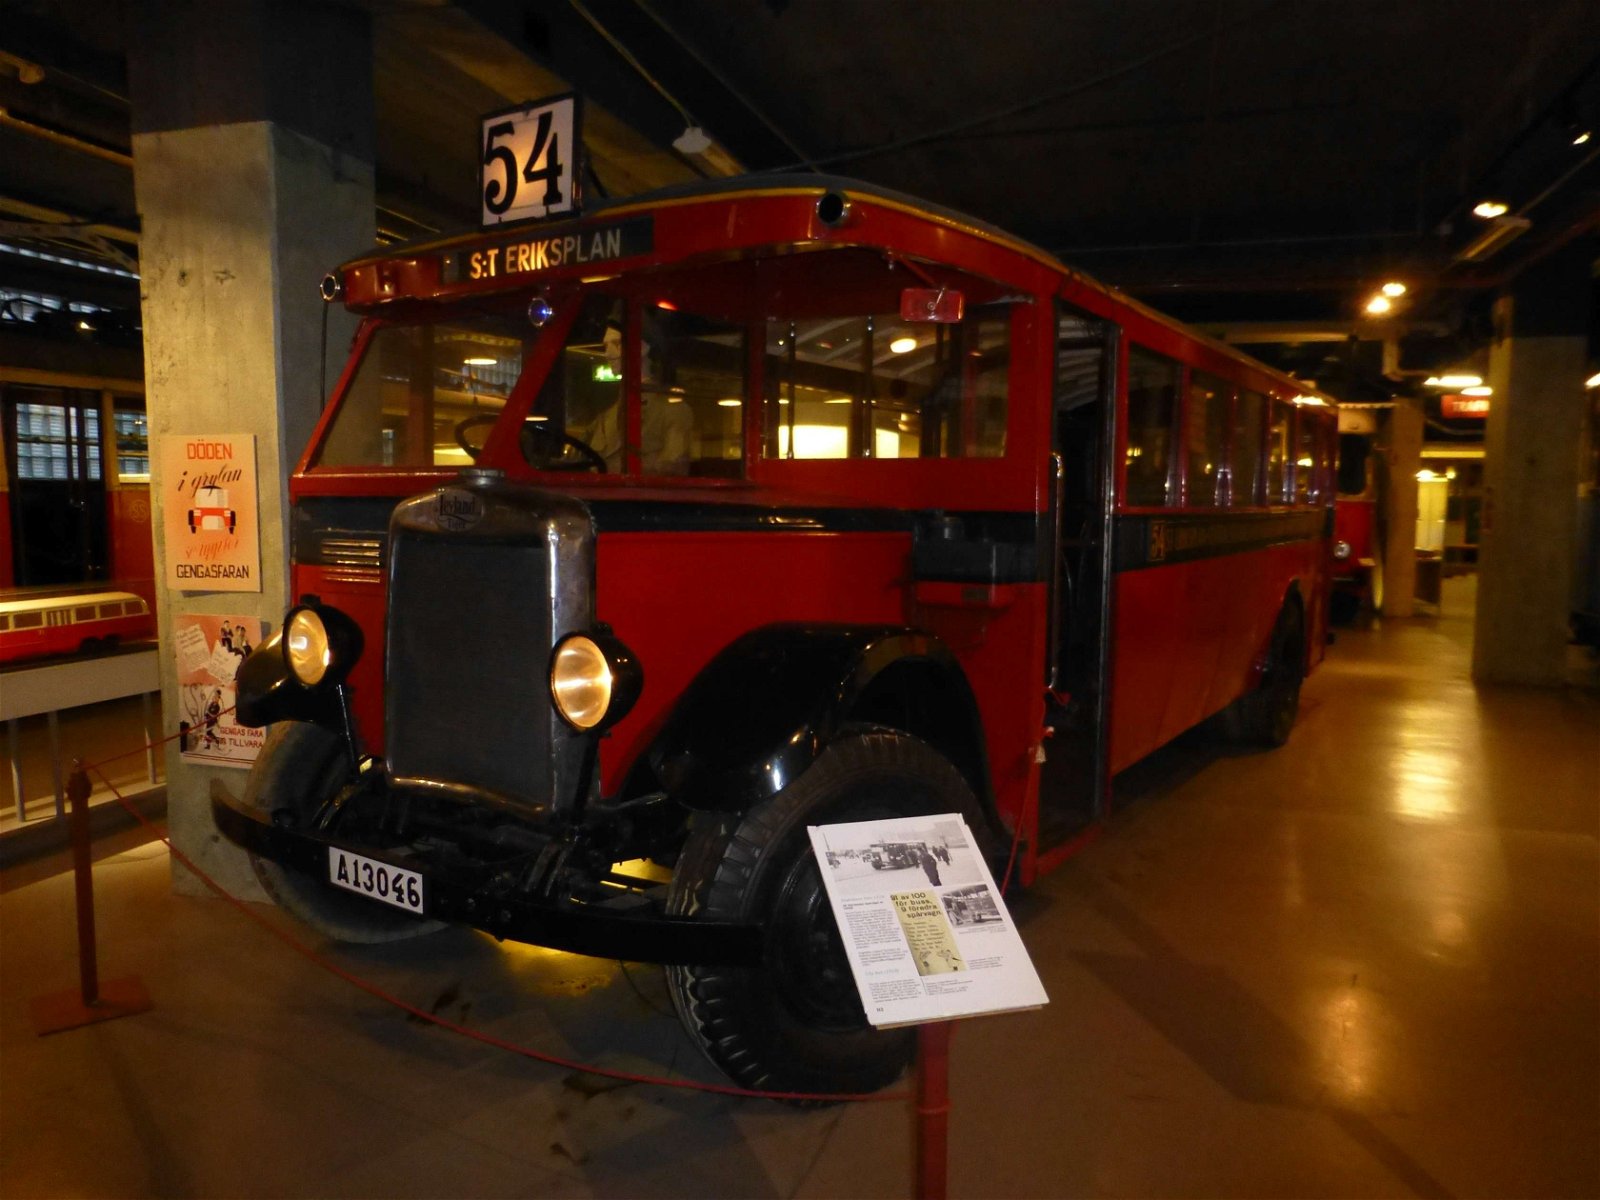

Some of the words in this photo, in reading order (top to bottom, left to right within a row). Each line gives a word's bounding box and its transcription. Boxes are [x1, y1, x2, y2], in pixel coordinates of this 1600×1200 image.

[484, 111, 563, 214] 54
[470, 248, 499, 279] S:T
[506, 228, 621, 273] ERIKSPLAN
[187, 439, 232, 459] DÖDEN
[176, 564, 250, 579] GENGASFARAN
[337, 853, 420, 907] A13046
[895, 899, 907, 907] för
[911, 892, 926, 900] 100
